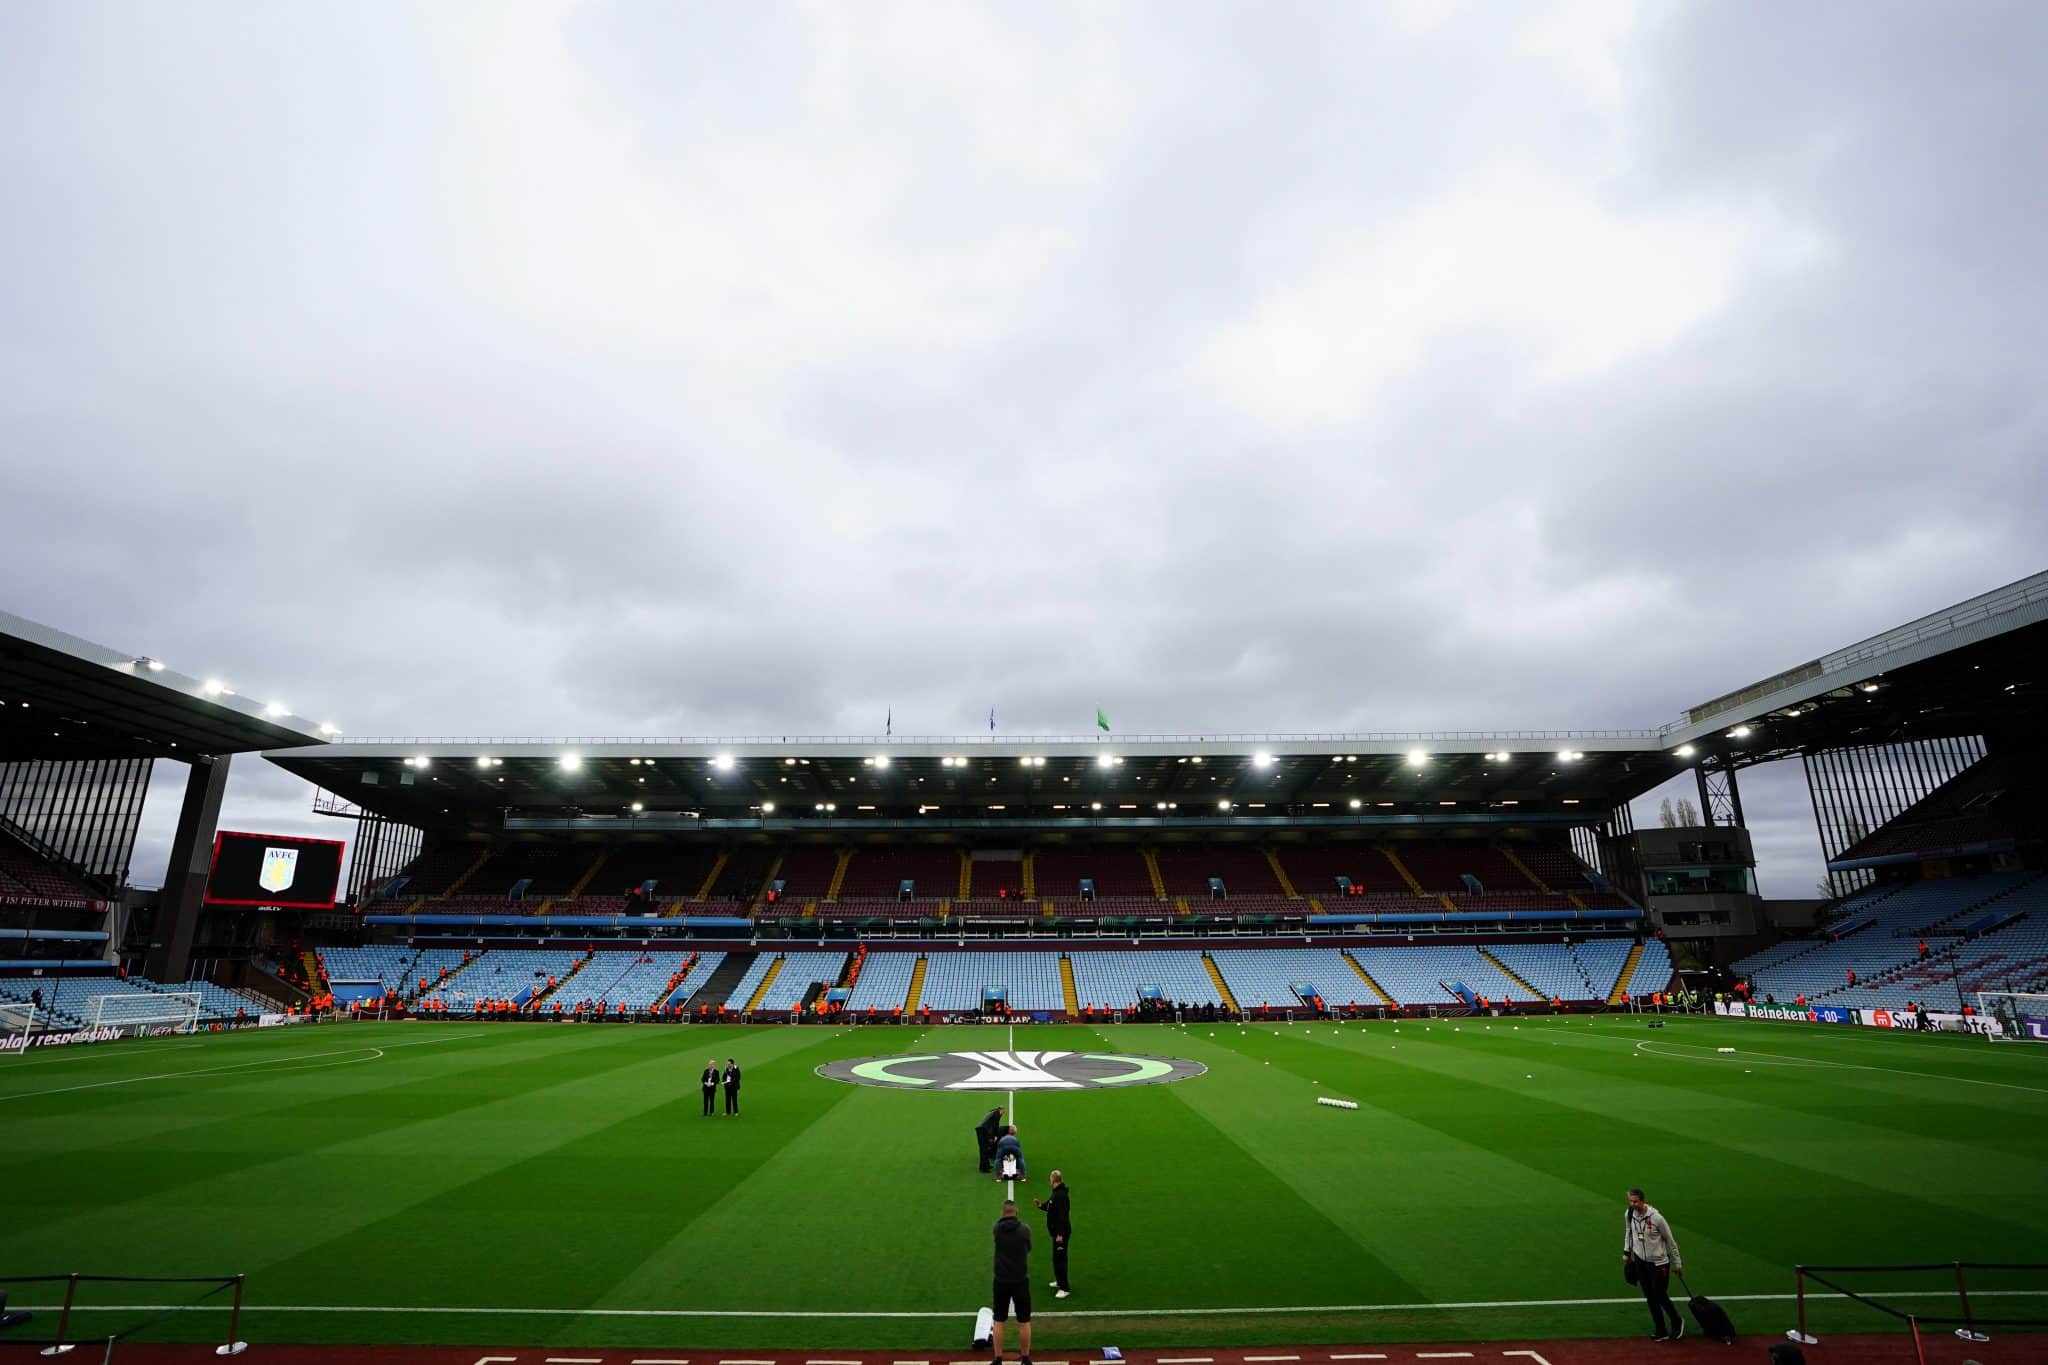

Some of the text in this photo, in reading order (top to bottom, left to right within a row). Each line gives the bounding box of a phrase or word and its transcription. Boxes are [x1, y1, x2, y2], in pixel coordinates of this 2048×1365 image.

[270, 850, 296, 860] AVFC
[20, 897, 50, 906] PETER
[1748, 1005, 1807, 1022] Heineken
